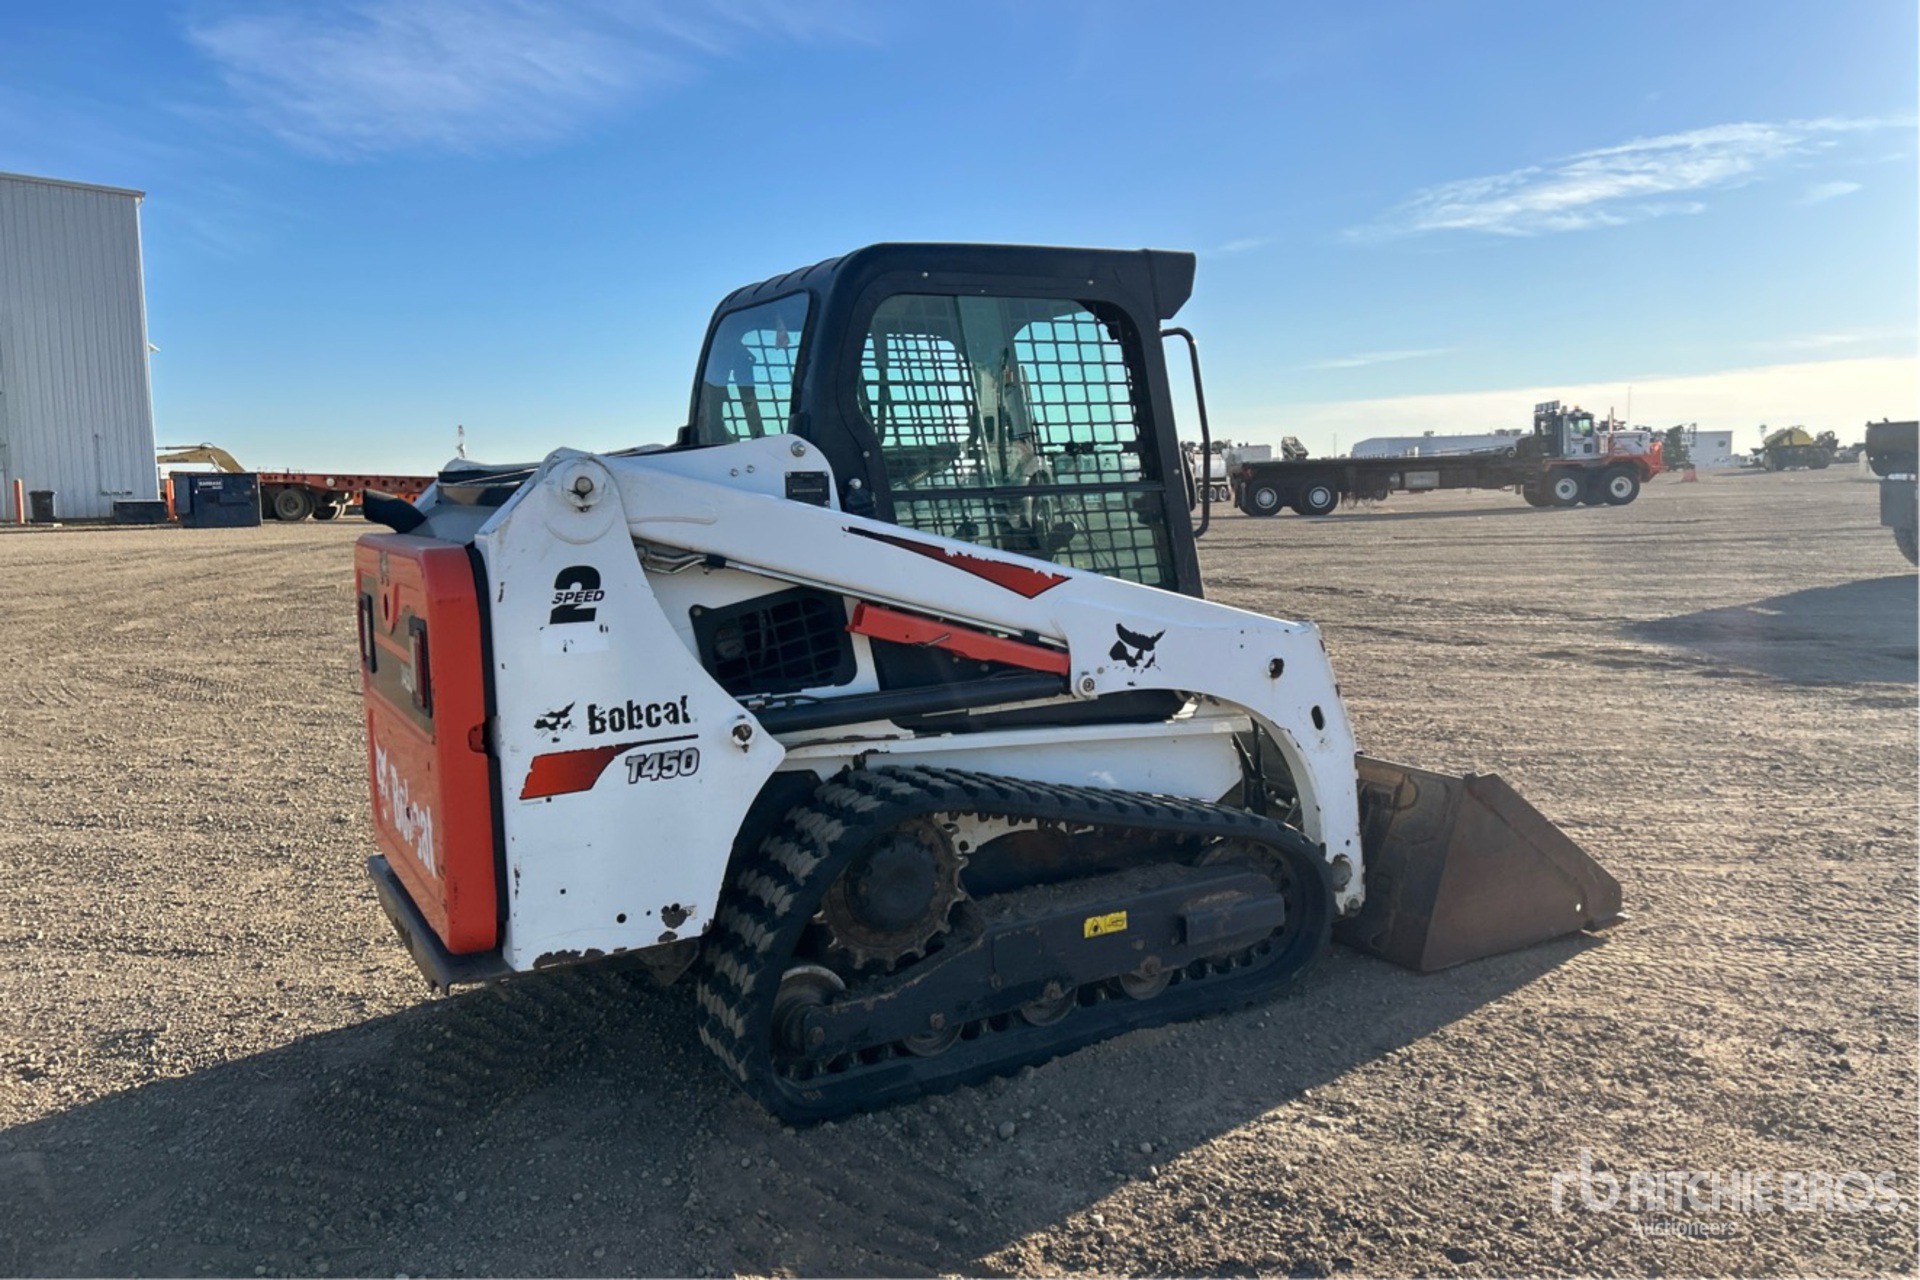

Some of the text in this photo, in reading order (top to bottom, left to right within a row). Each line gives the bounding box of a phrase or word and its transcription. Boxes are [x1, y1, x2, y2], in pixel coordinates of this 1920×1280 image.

[550, 565, 601, 624] 2
[552, 590, 605, 604] SPEED
[587, 695, 691, 735] Bobcat
[625, 747, 700, 784] T450
